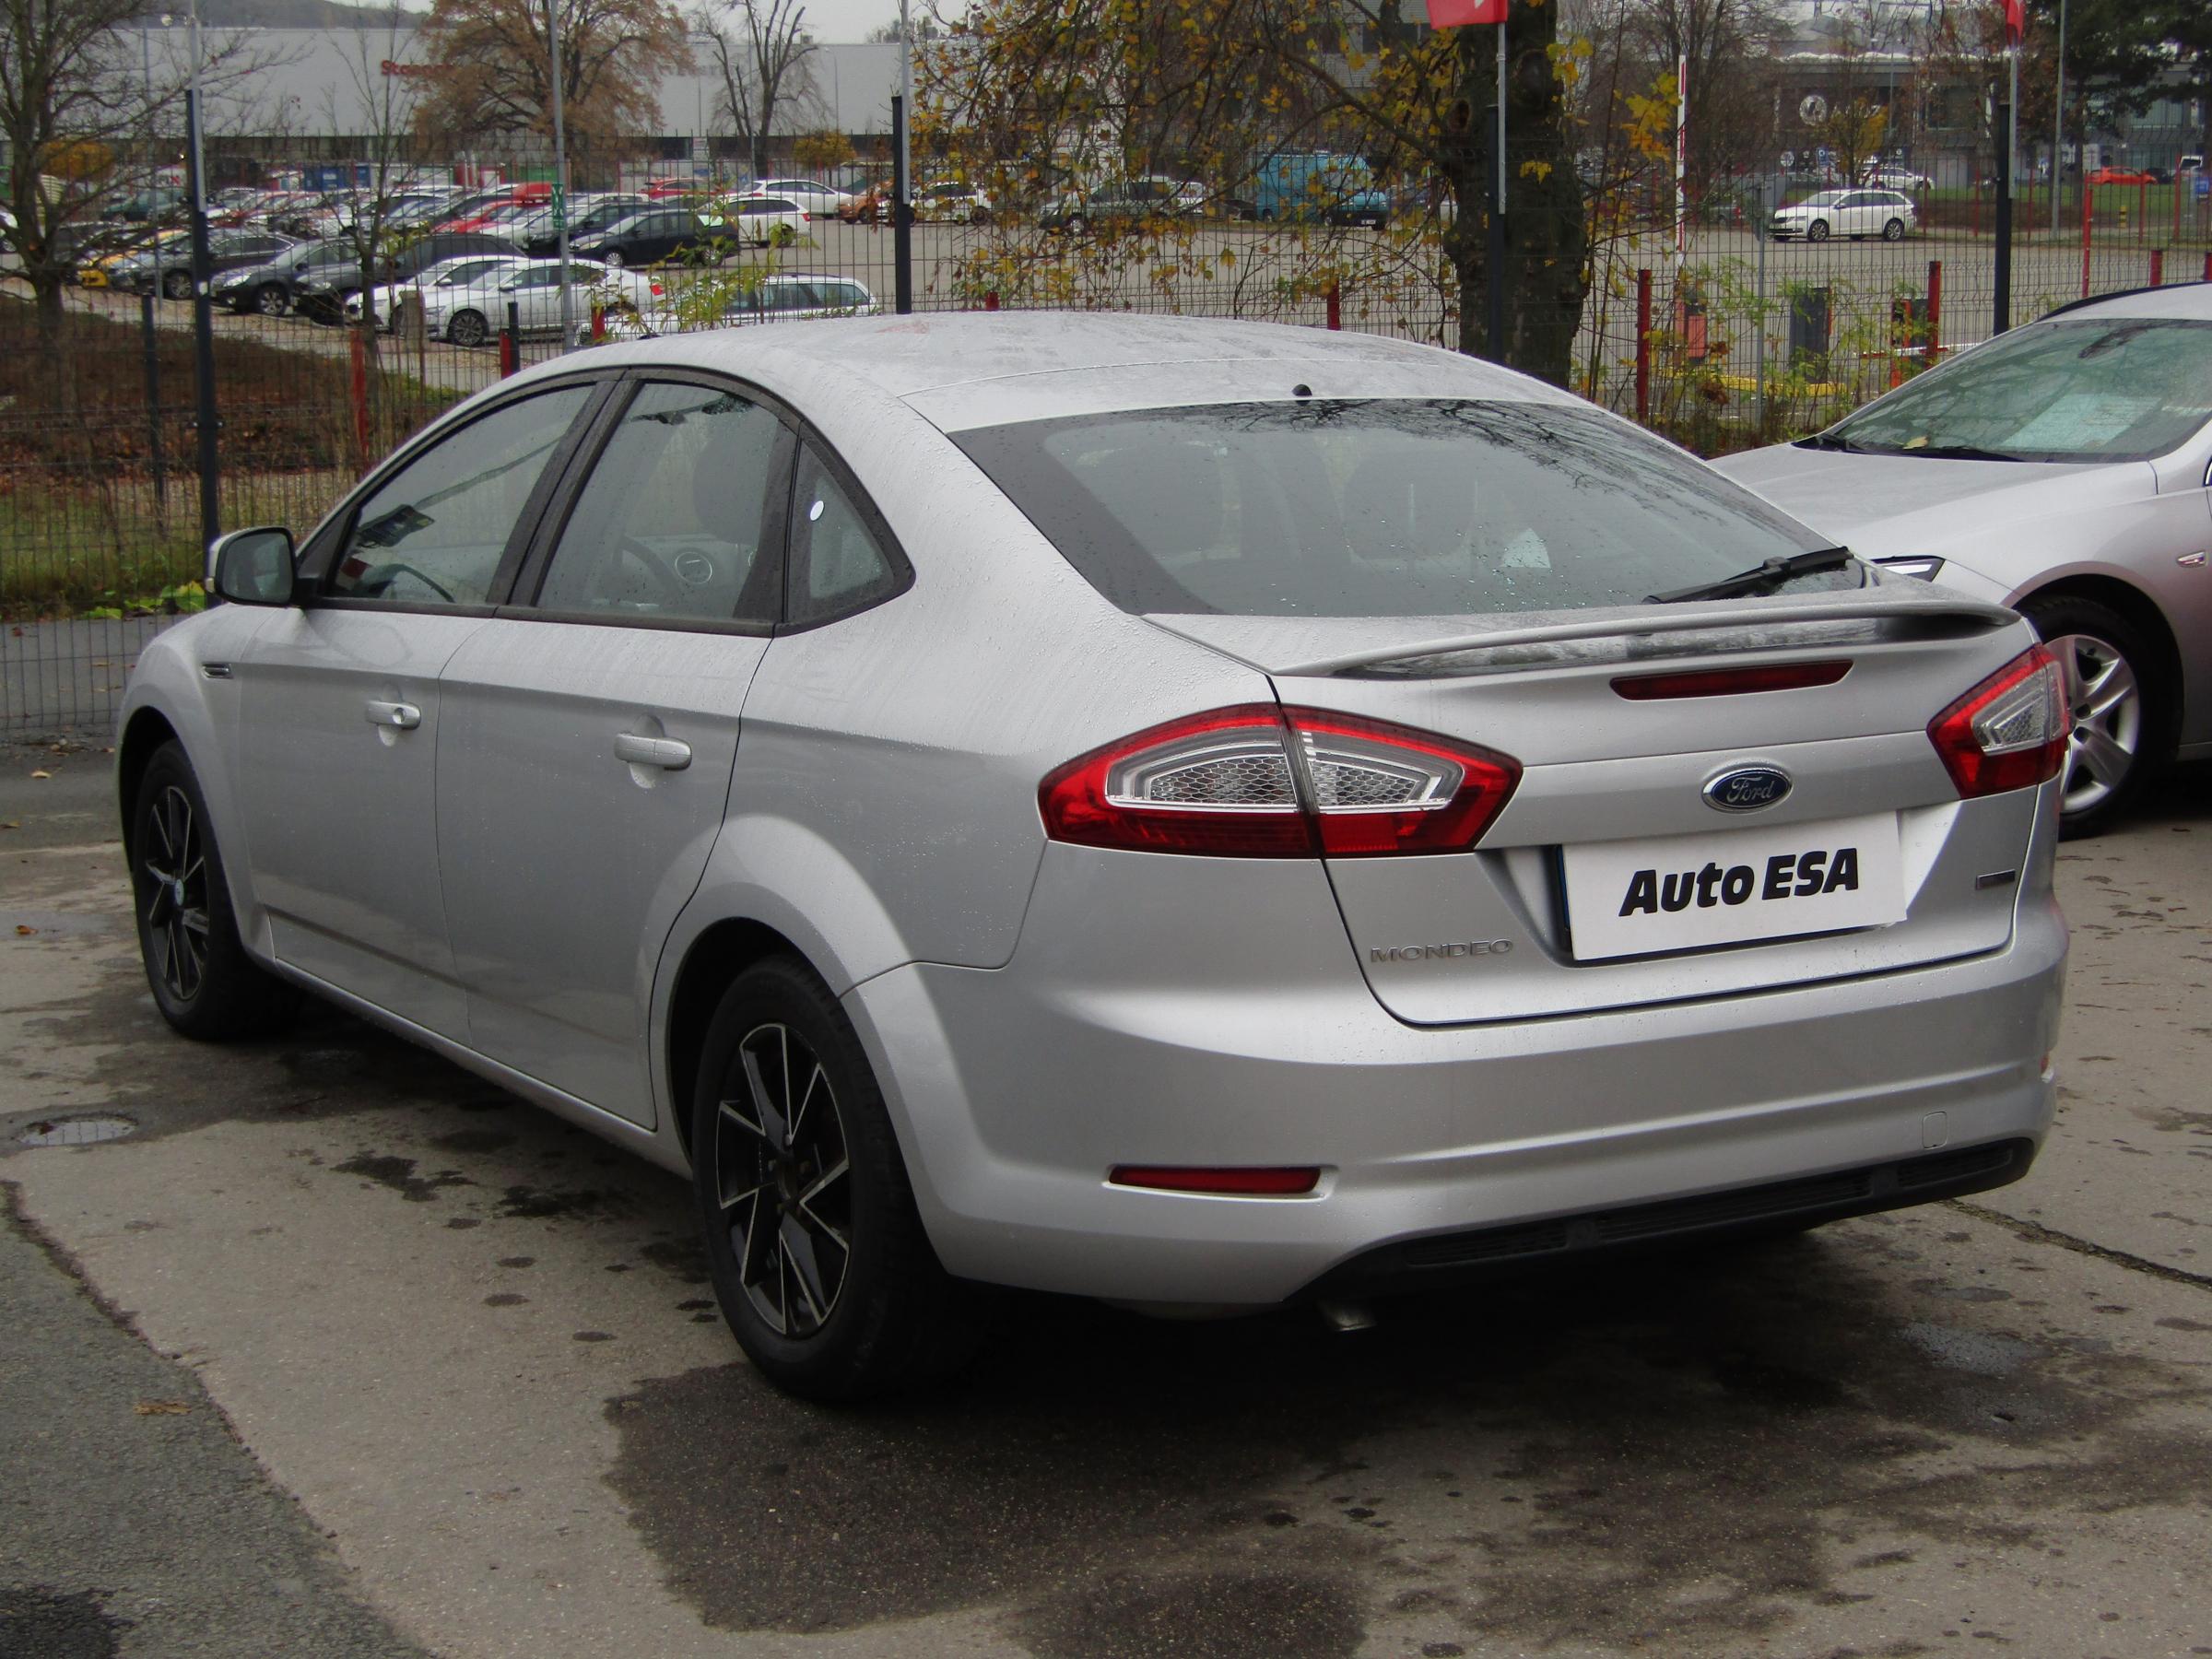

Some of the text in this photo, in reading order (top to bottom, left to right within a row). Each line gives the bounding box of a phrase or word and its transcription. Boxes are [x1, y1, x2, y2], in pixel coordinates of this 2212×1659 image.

[1726, 776, 1775, 802] Ford
[1618, 847, 1859, 916] Auto ESA
[1371, 938, 1513, 963] MONDEO
